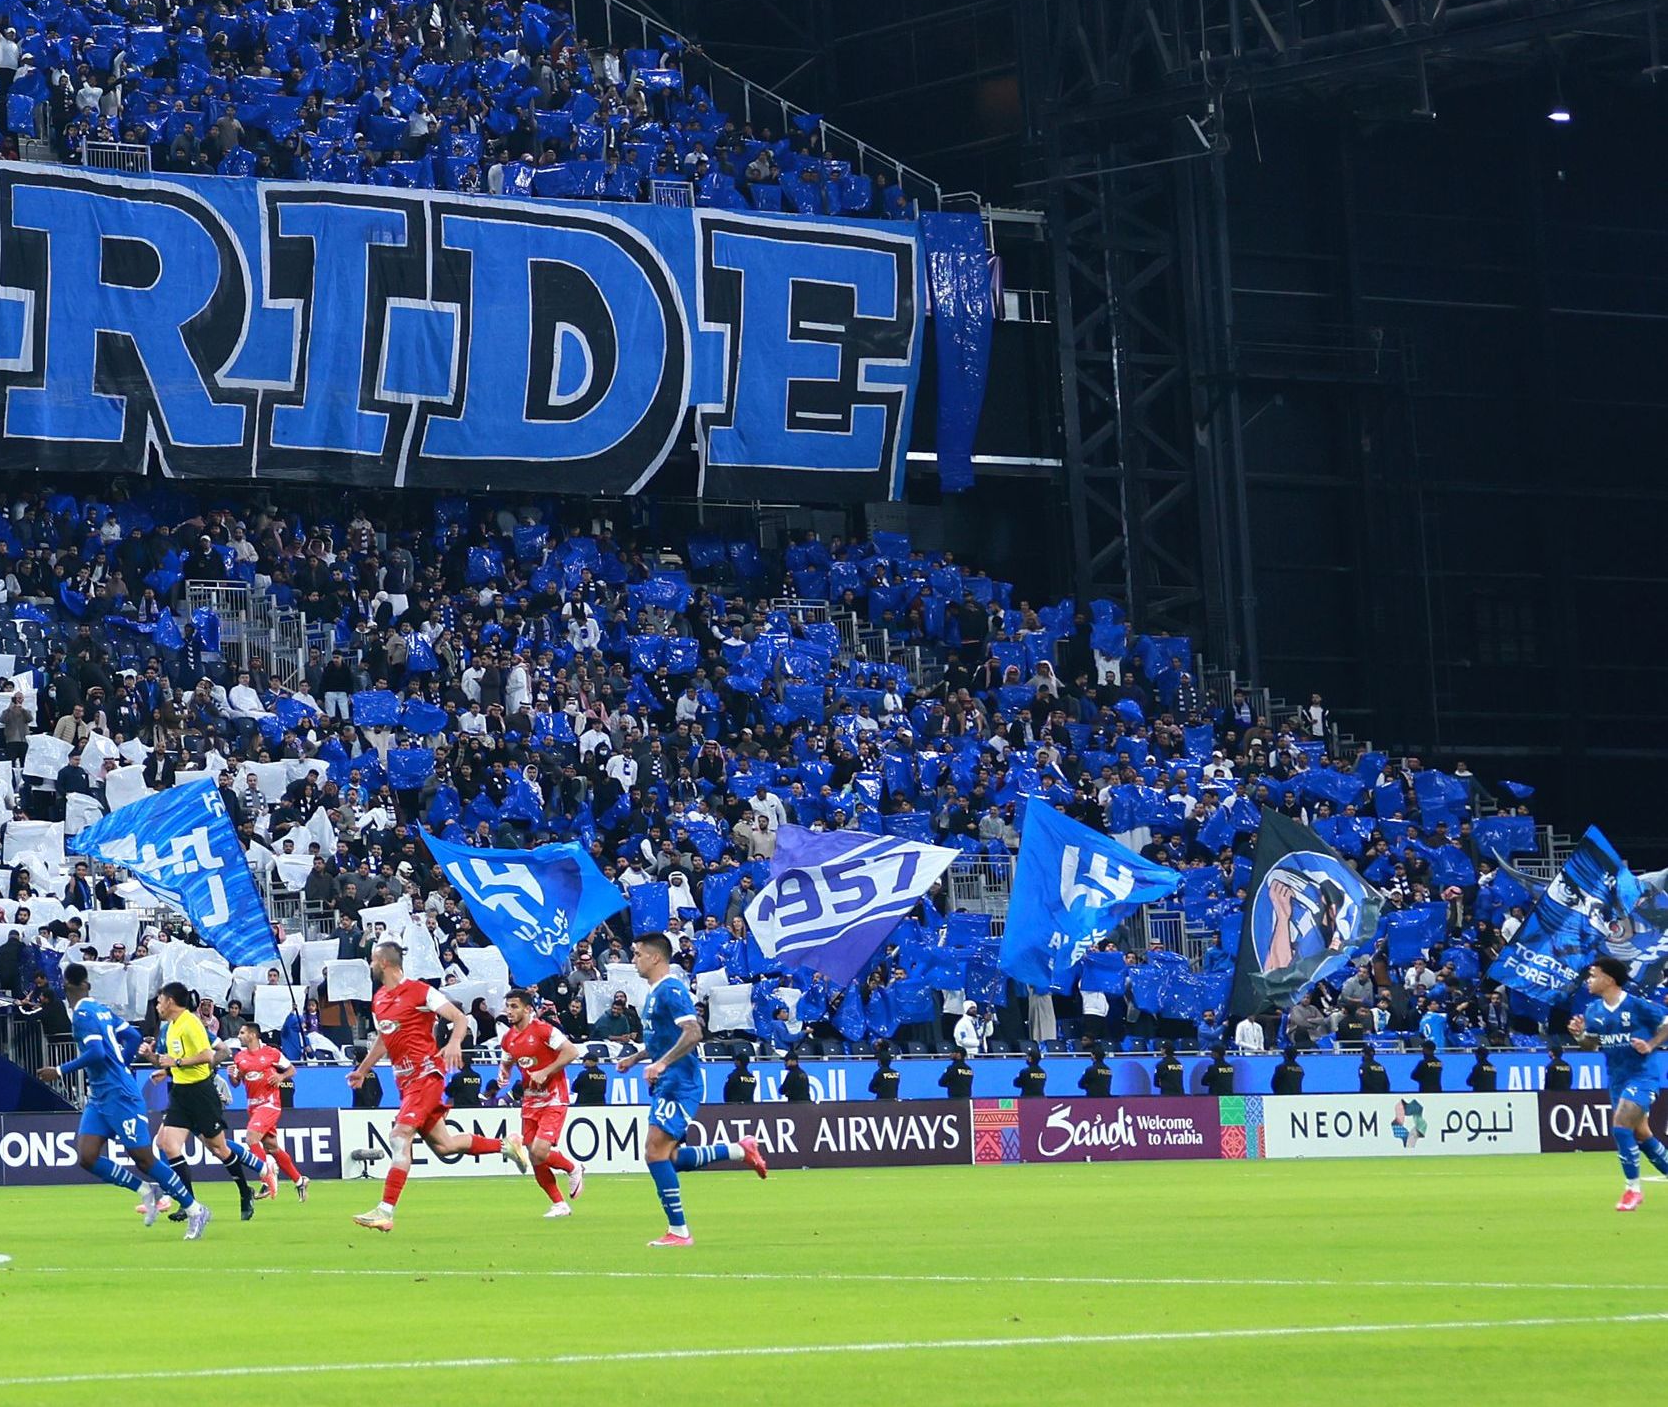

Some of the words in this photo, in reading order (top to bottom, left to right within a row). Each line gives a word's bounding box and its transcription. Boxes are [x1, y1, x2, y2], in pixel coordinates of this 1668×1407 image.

[1503, 956, 1566, 990] FOREV
[655, 1098, 675, 1119] 20
[1137, 1115, 1193, 1130] Welcome
[1291, 1110, 1378, 1139] NEOM
[1441, 1101, 1513, 1142] نيوم
[1550, 1104, 1613, 1141] QAT
[122, 1118, 136, 1135] 87
[814, 1114, 960, 1152] AIRWAYS
[1038, 1103, 1137, 1156] Saudi
[1148, 1132, 1162, 1145] to
[1164, 1131, 1203, 1145] Arabia
[233, 1127, 332, 1165] EITE
